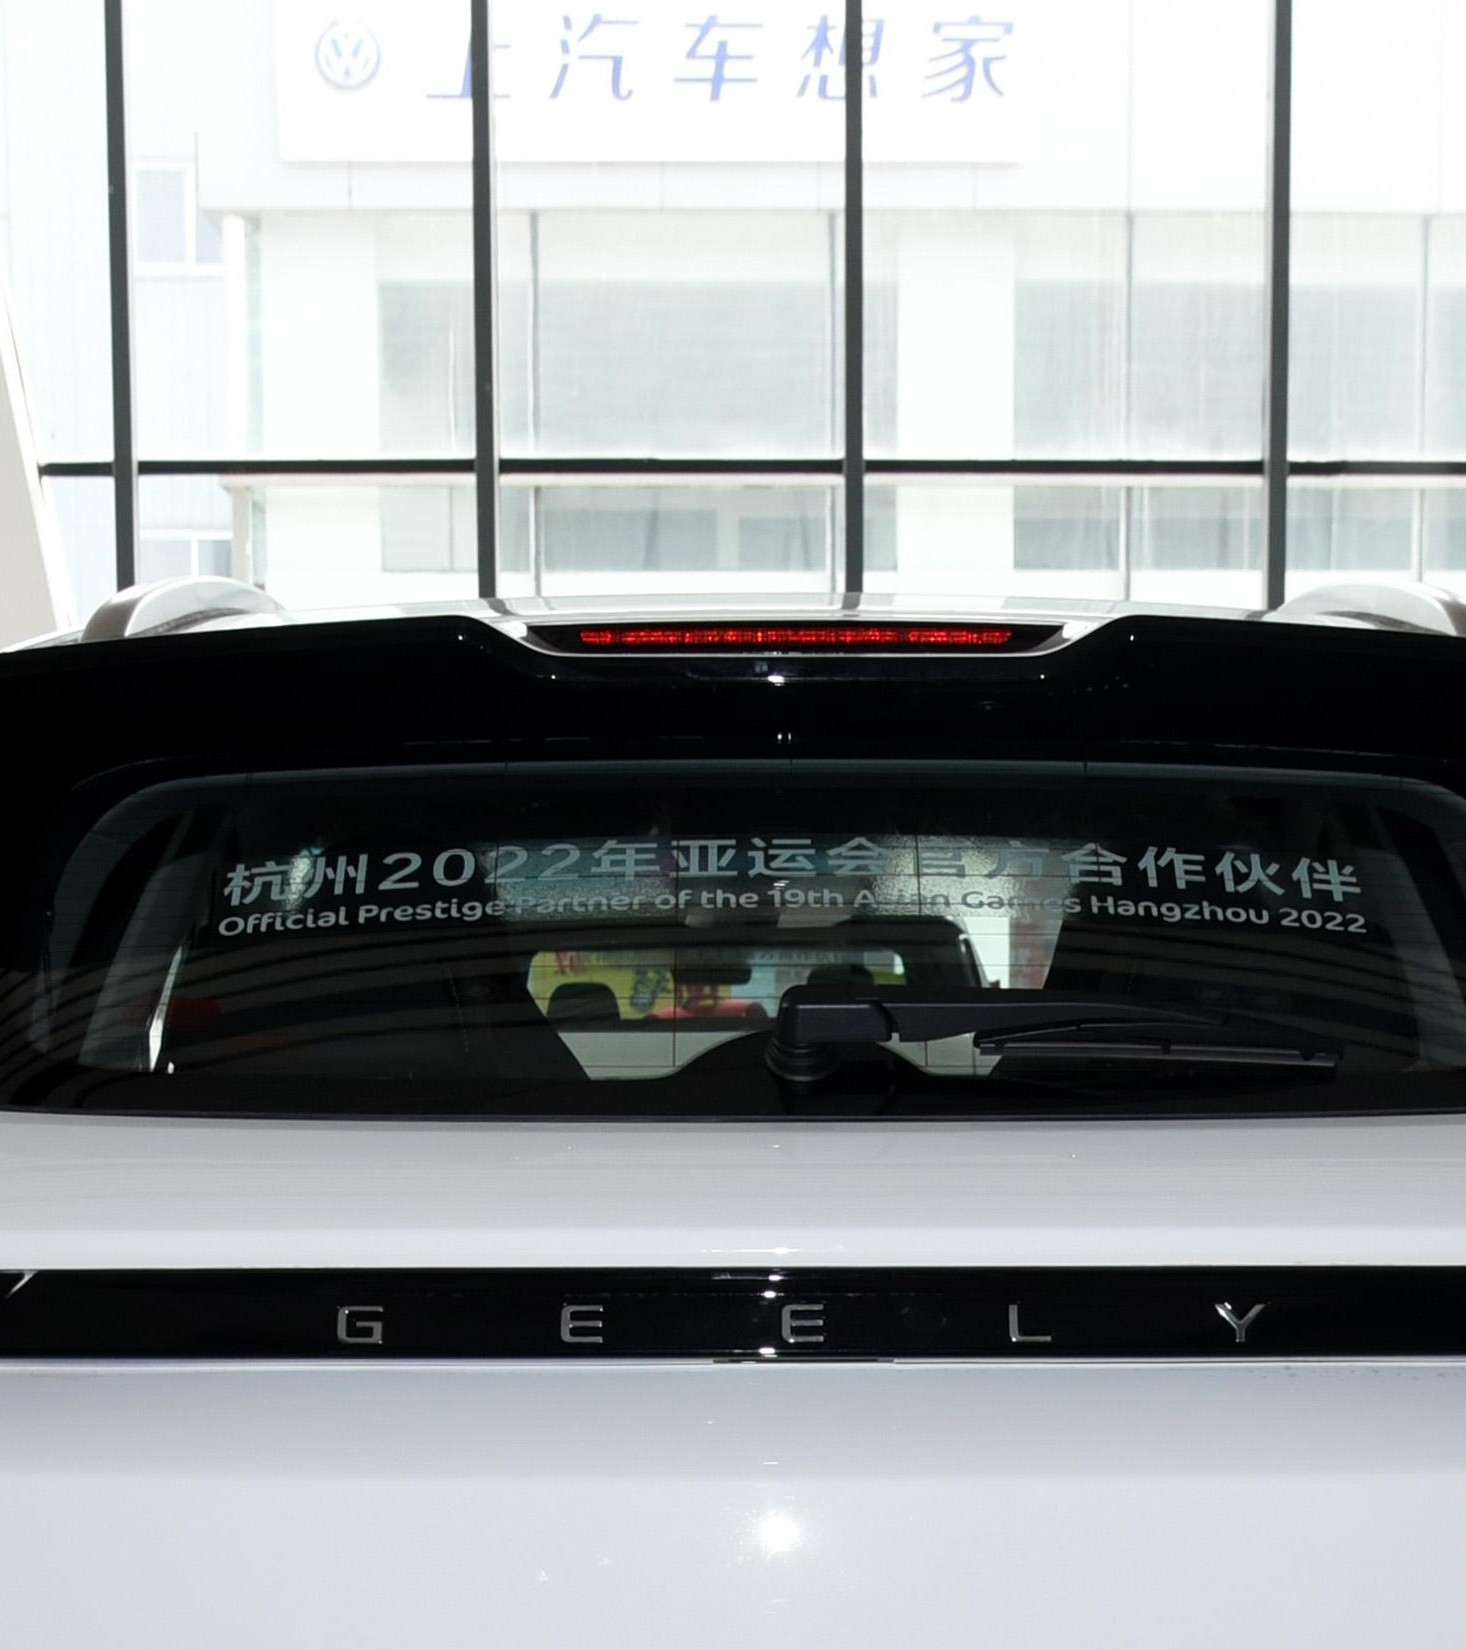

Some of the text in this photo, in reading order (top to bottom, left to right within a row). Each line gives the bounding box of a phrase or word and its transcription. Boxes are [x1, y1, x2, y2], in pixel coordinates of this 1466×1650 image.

[218, 905, 349, 937] Official
[358, 898, 506, 924] Prestige
[516, 892, 640, 915] Partner
[655, 889, 693, 910] of
[700, 888, 759, 908] the
[772, 888, 845, 909] 19th
[1090, 895, 1271, 926] Hangzhou
[1279, 906, 1368, 934] 2022
[335, 1302, 1266, 1345] GEELY
